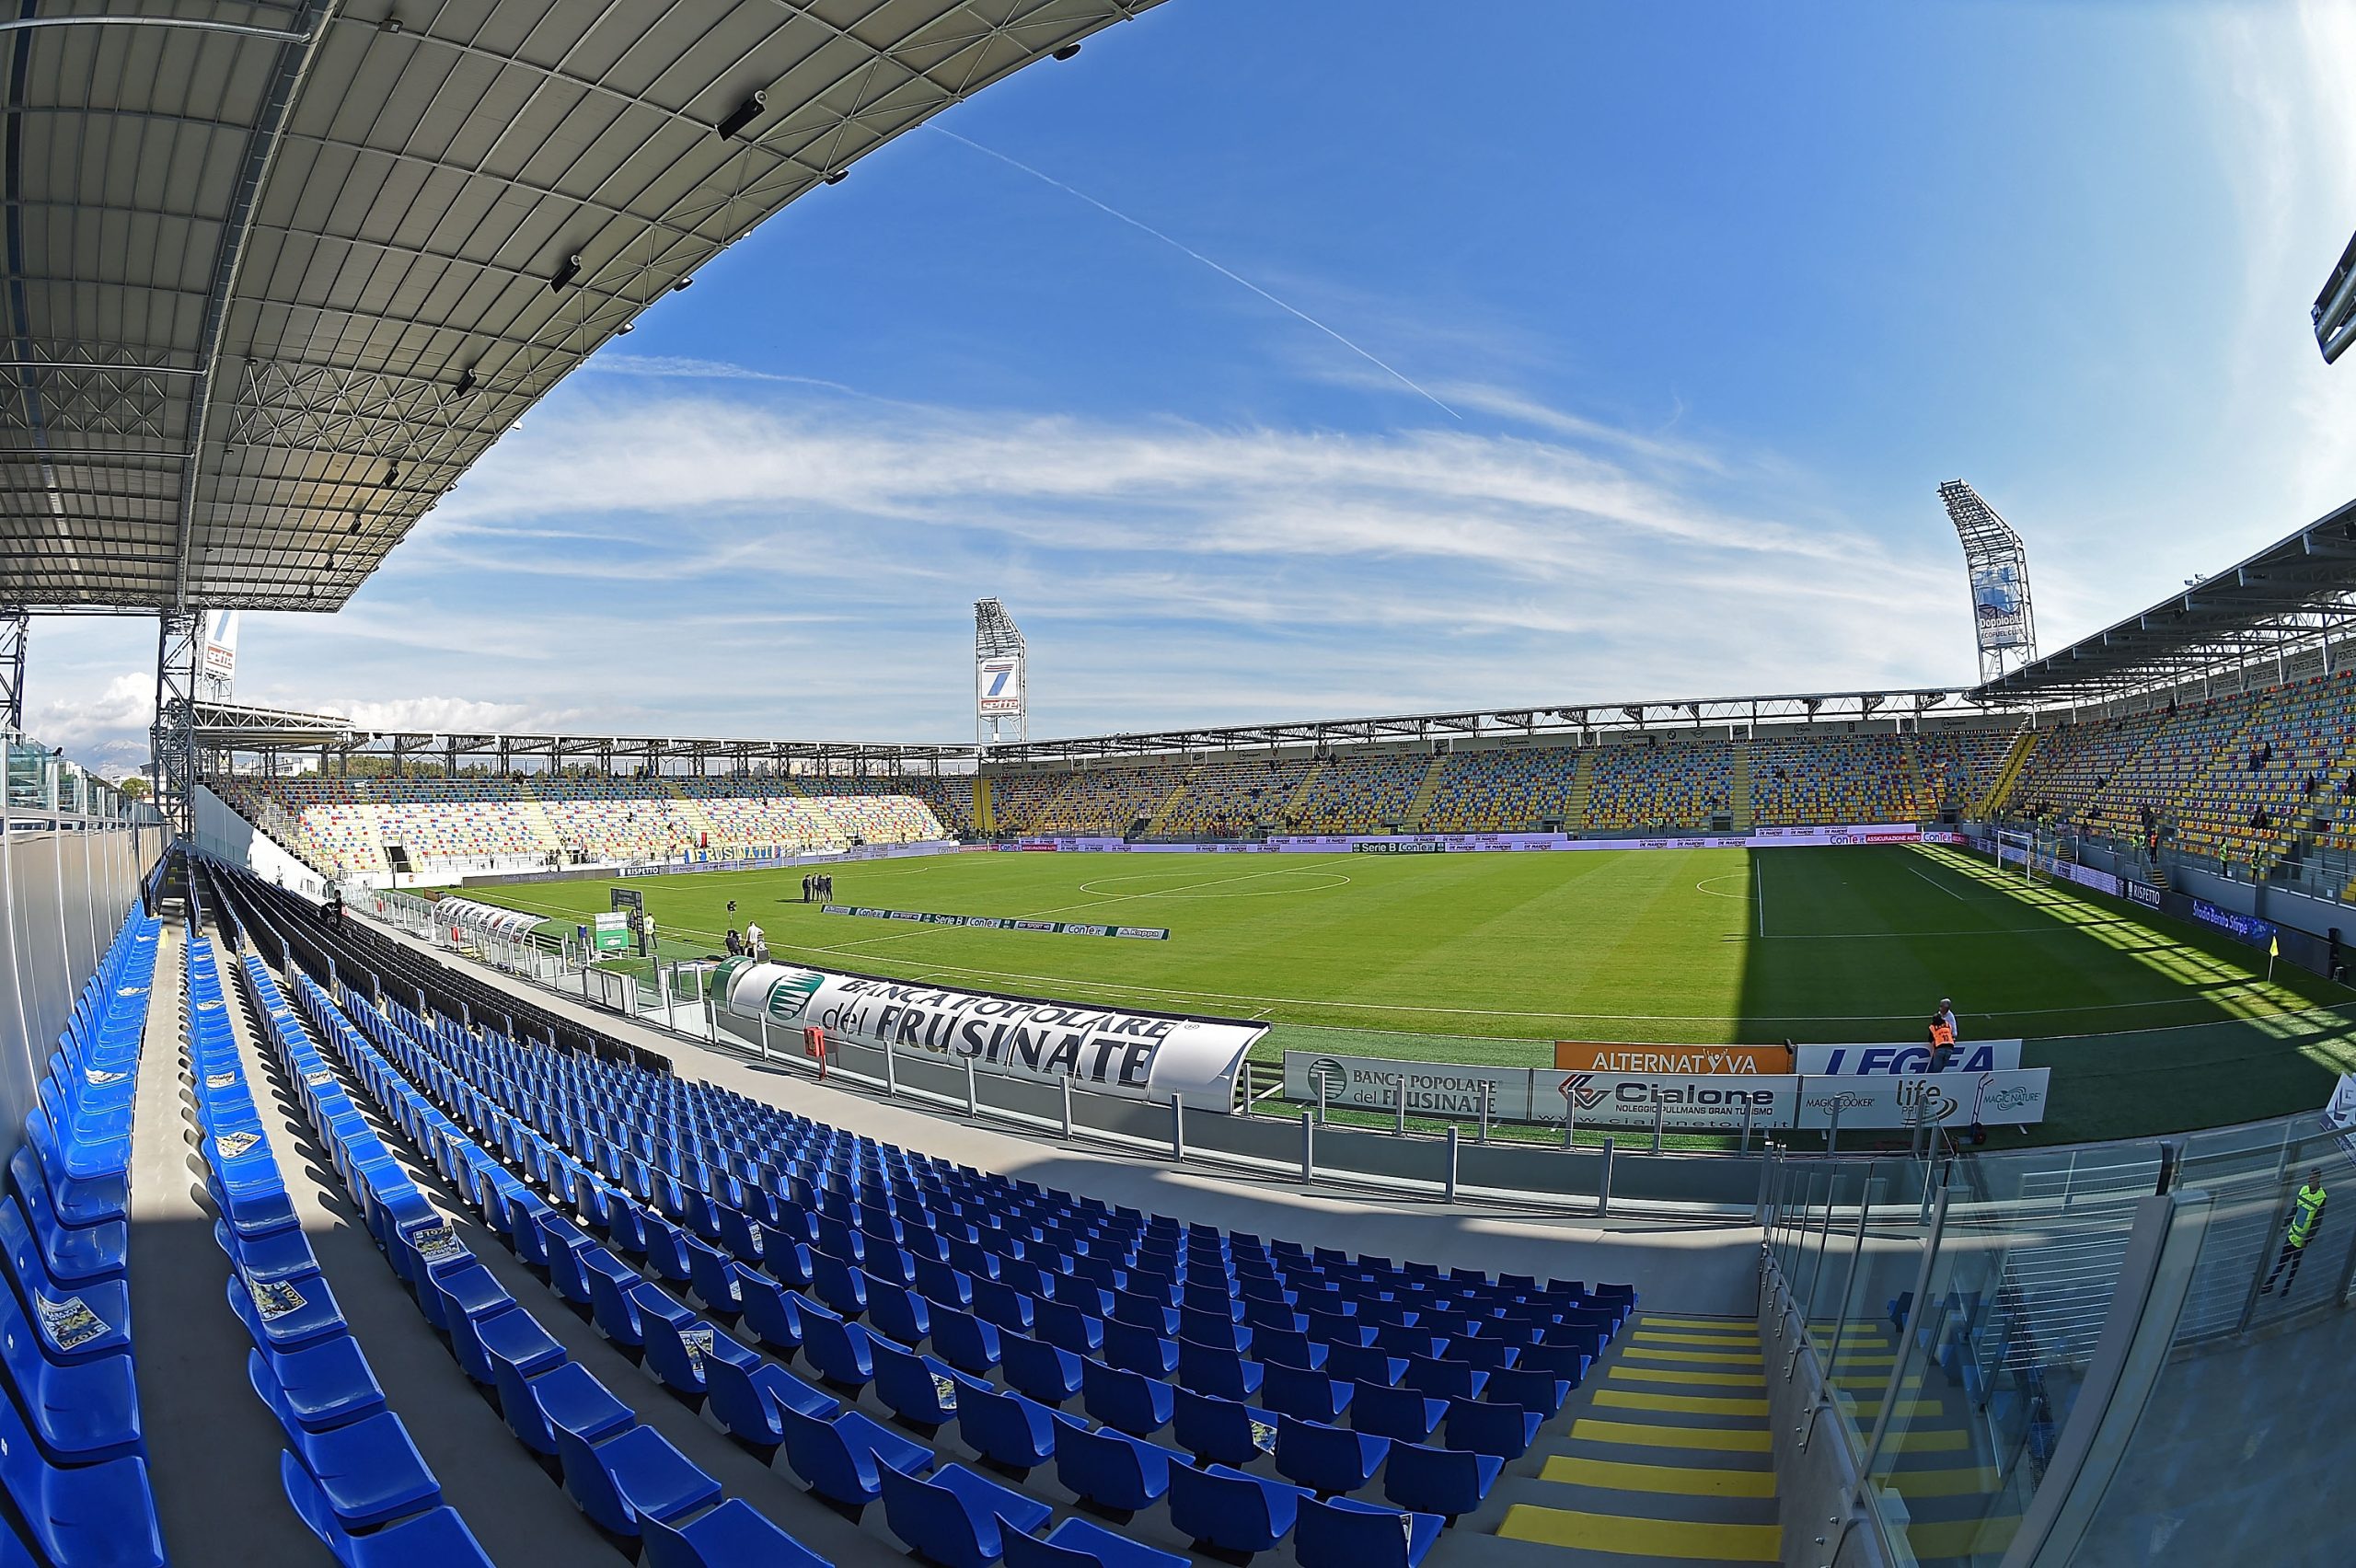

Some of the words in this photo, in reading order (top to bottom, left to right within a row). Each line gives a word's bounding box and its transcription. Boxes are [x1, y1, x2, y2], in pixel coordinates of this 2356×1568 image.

[1362, 843, 1386, 852] Serie
[1389, 843, 1396, 852] B
[627, 866, 659, 876] RISPETTO
[2133, 884, 2161, 905] RISPETTO
[934, 915, 954, 925] Serie
[955, 917, 964, 926] B
[2192, 900, 2210, 921] Stadio
[2211, 907, 2228, 928] Benito
[2229, 915, 2247, 936] Stirpe
[1130, 928, 1160, 938] Kappa
[837, 979, 950, 1008] BANCA
[951, 994, 1177, 1039] POPOLARE
[822, 1002, 863, 1037] del
[872, 1004, 1162, 1090] FRUSINATE
[1353, 1069, 1406, 1087] BANCA
[1353, 1090, 1377, 1104] del
[1615, 1081, 1774, 1106] Cialone
[1896, 1079, 1941, 1105] life
[1983, 1094, 2009, 1103] MAGIC
[2010, 1092, 2039, 1102] NATURE
[1615, 1104, 1657, 1113] NOLEGGIO
[1708, 1107, 1732, 1115] GRAN
[425, 1227, 452, 1237] 1928
[282, 1286, 304, 1308] 1928
